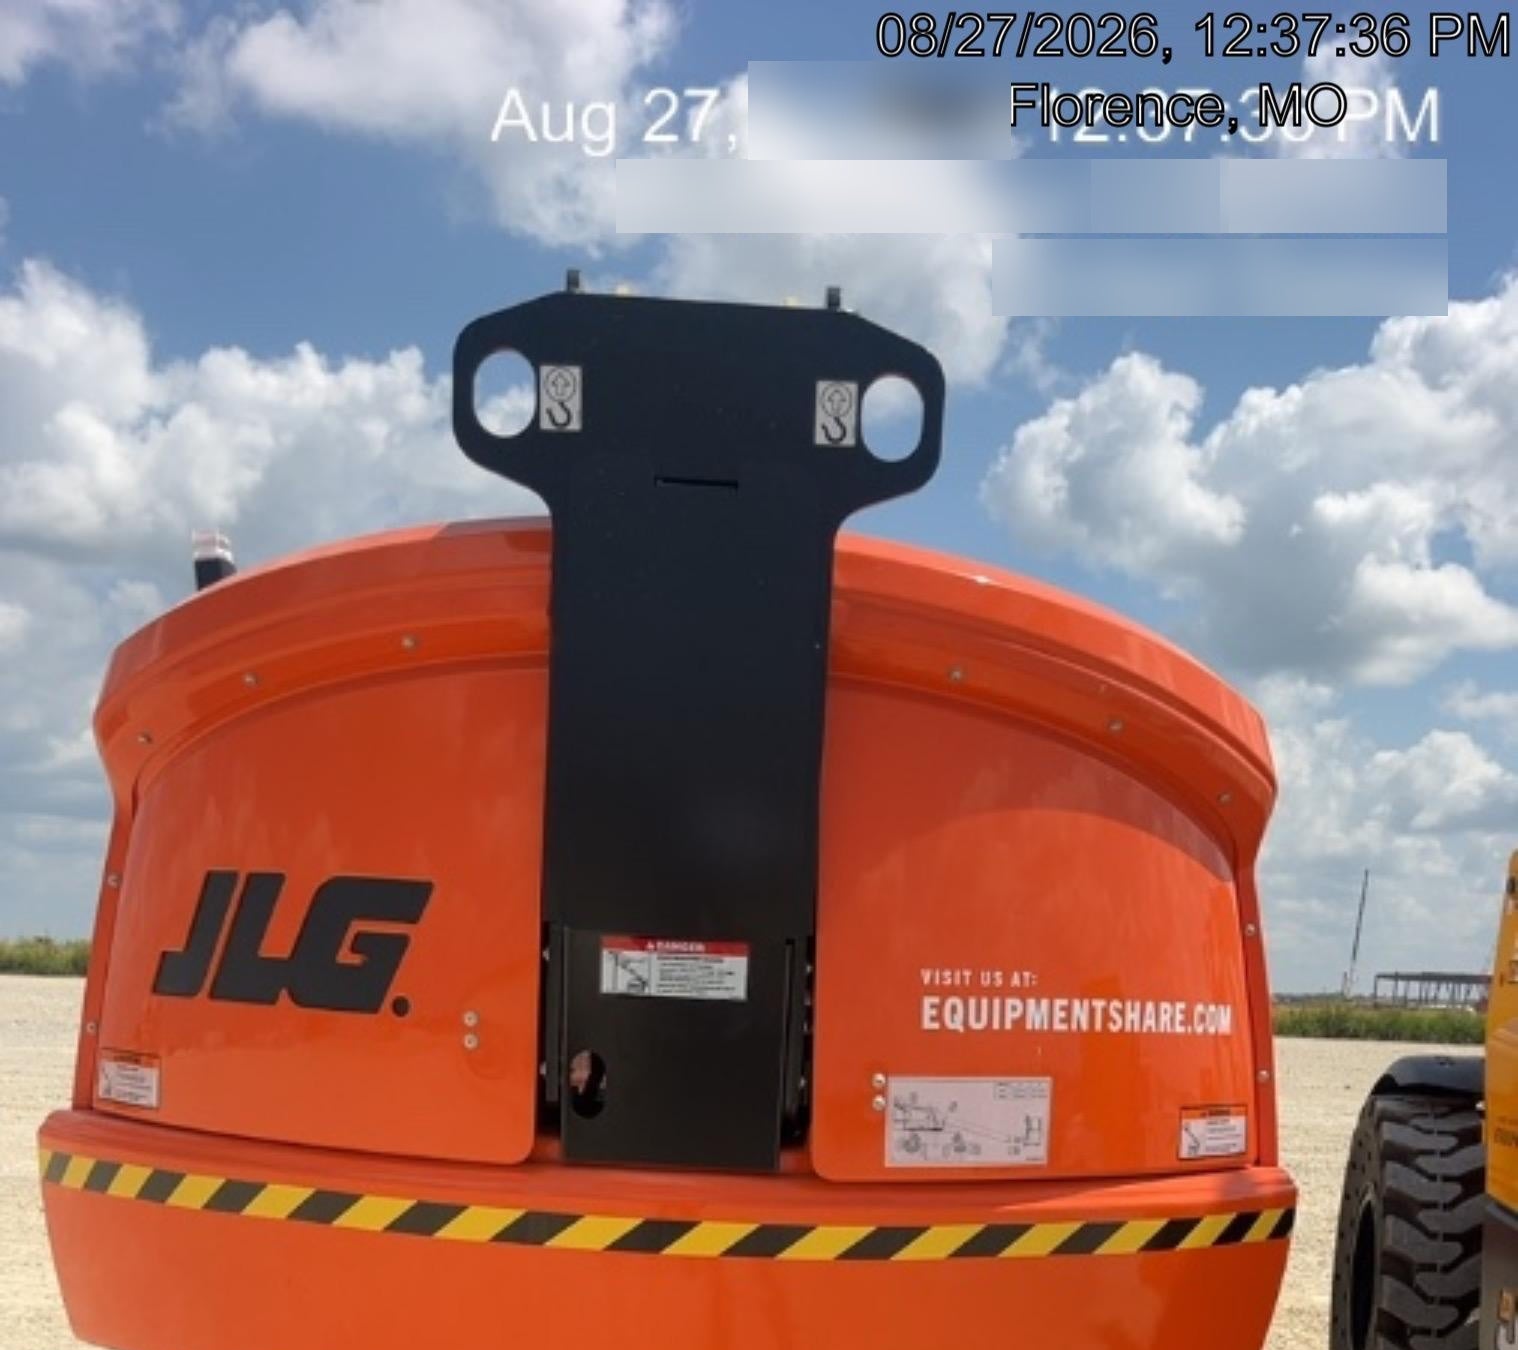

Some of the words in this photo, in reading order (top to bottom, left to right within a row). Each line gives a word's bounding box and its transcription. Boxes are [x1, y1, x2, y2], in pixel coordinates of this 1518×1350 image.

[920, 968, 972, 986] VISIT
[980, 970, 1003, 987] US
[1010, 971, 1038, 988] AT:
[921, 995, 1232, 1036] EQUIPMENTSHARE.COM
